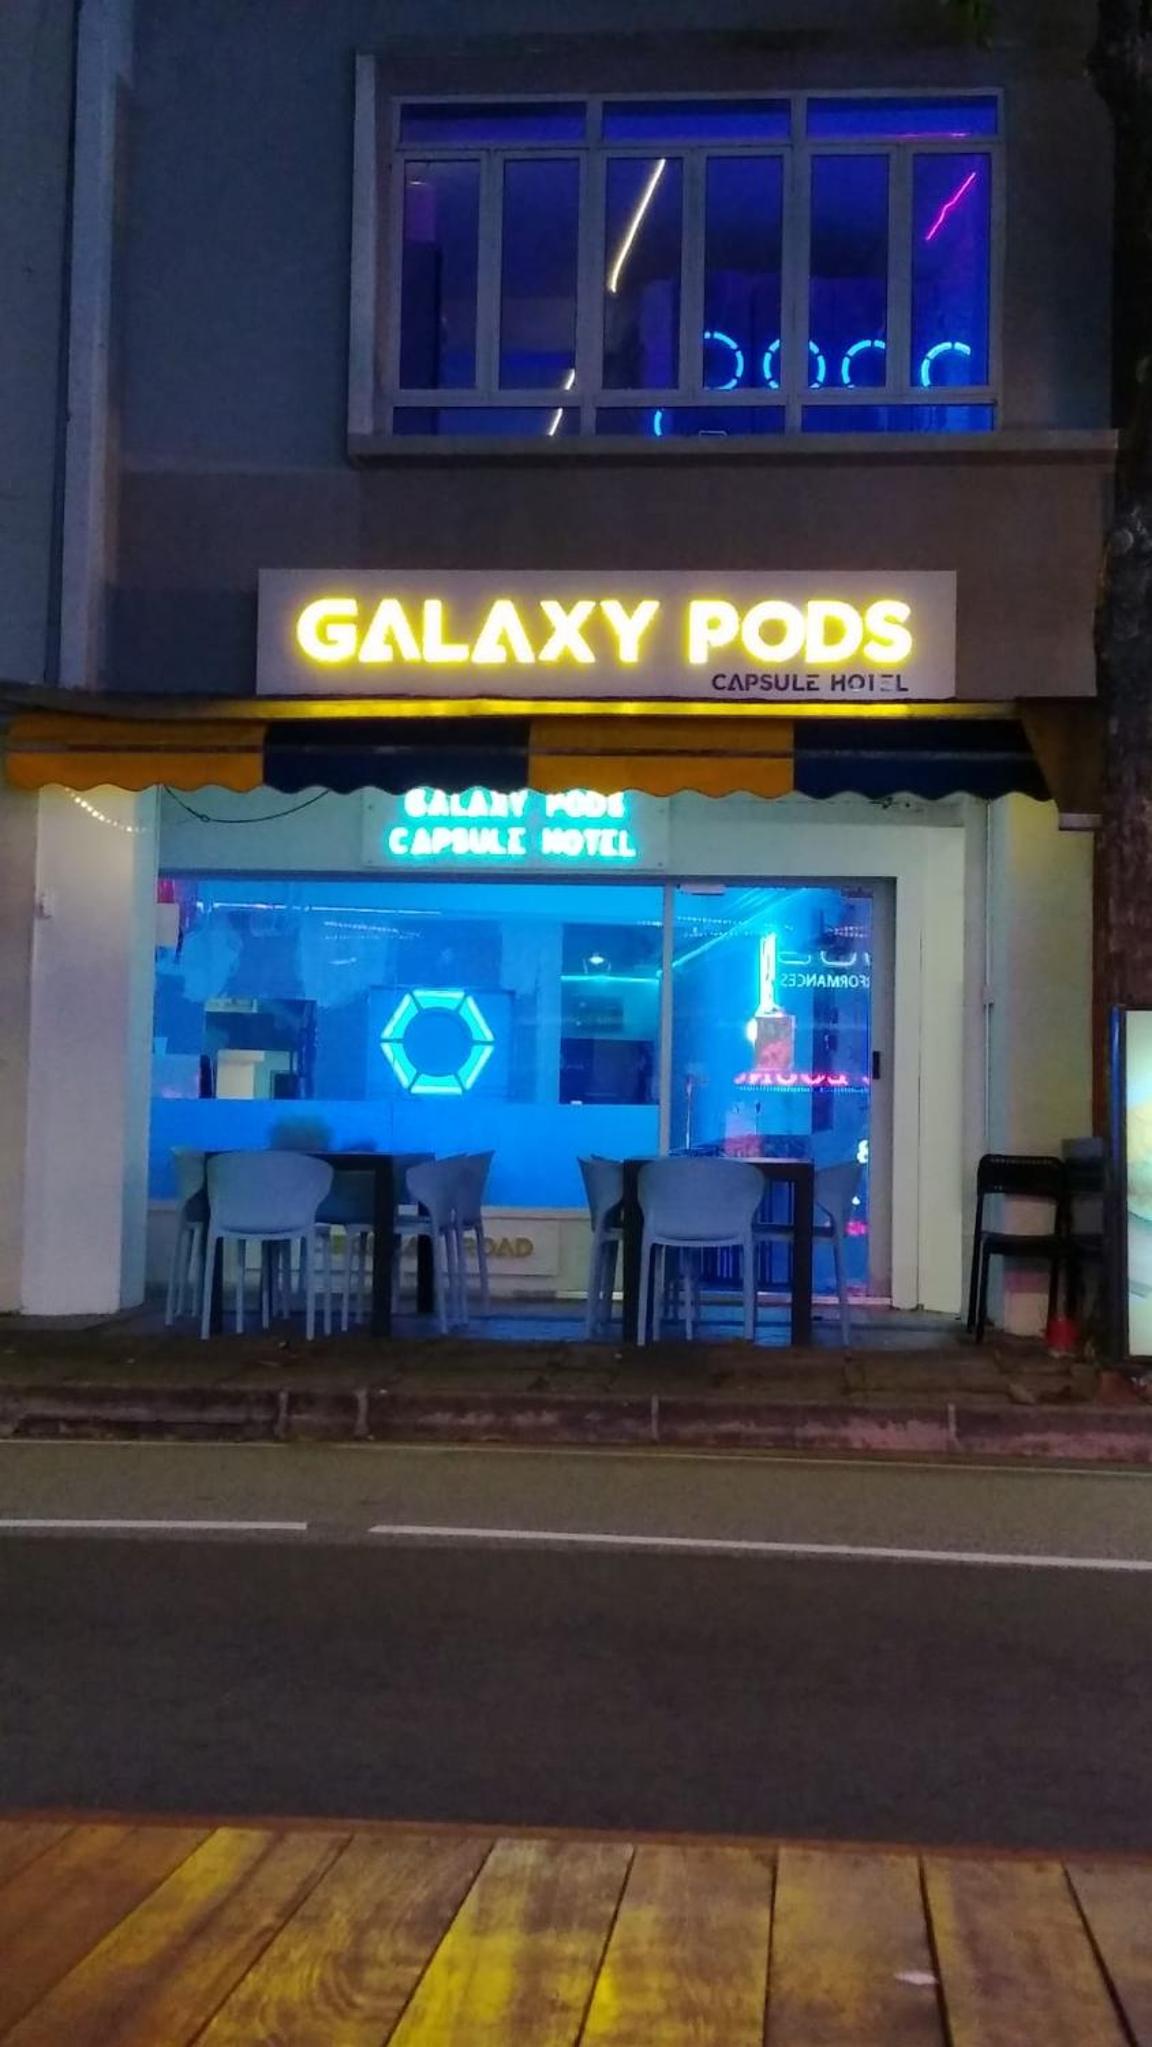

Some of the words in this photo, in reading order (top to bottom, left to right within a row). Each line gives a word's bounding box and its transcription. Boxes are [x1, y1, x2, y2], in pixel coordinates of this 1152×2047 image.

[296, 598, 660, 665] GALAXY
[687, 599, 914, 667] PODS
[711, 673, 821, 692] CAPSULE
[830, 674, 909, 692] HOTEL
[388, 826, 527, 856] CAPSULE
[541, 828, 637, 858] HOTEL
